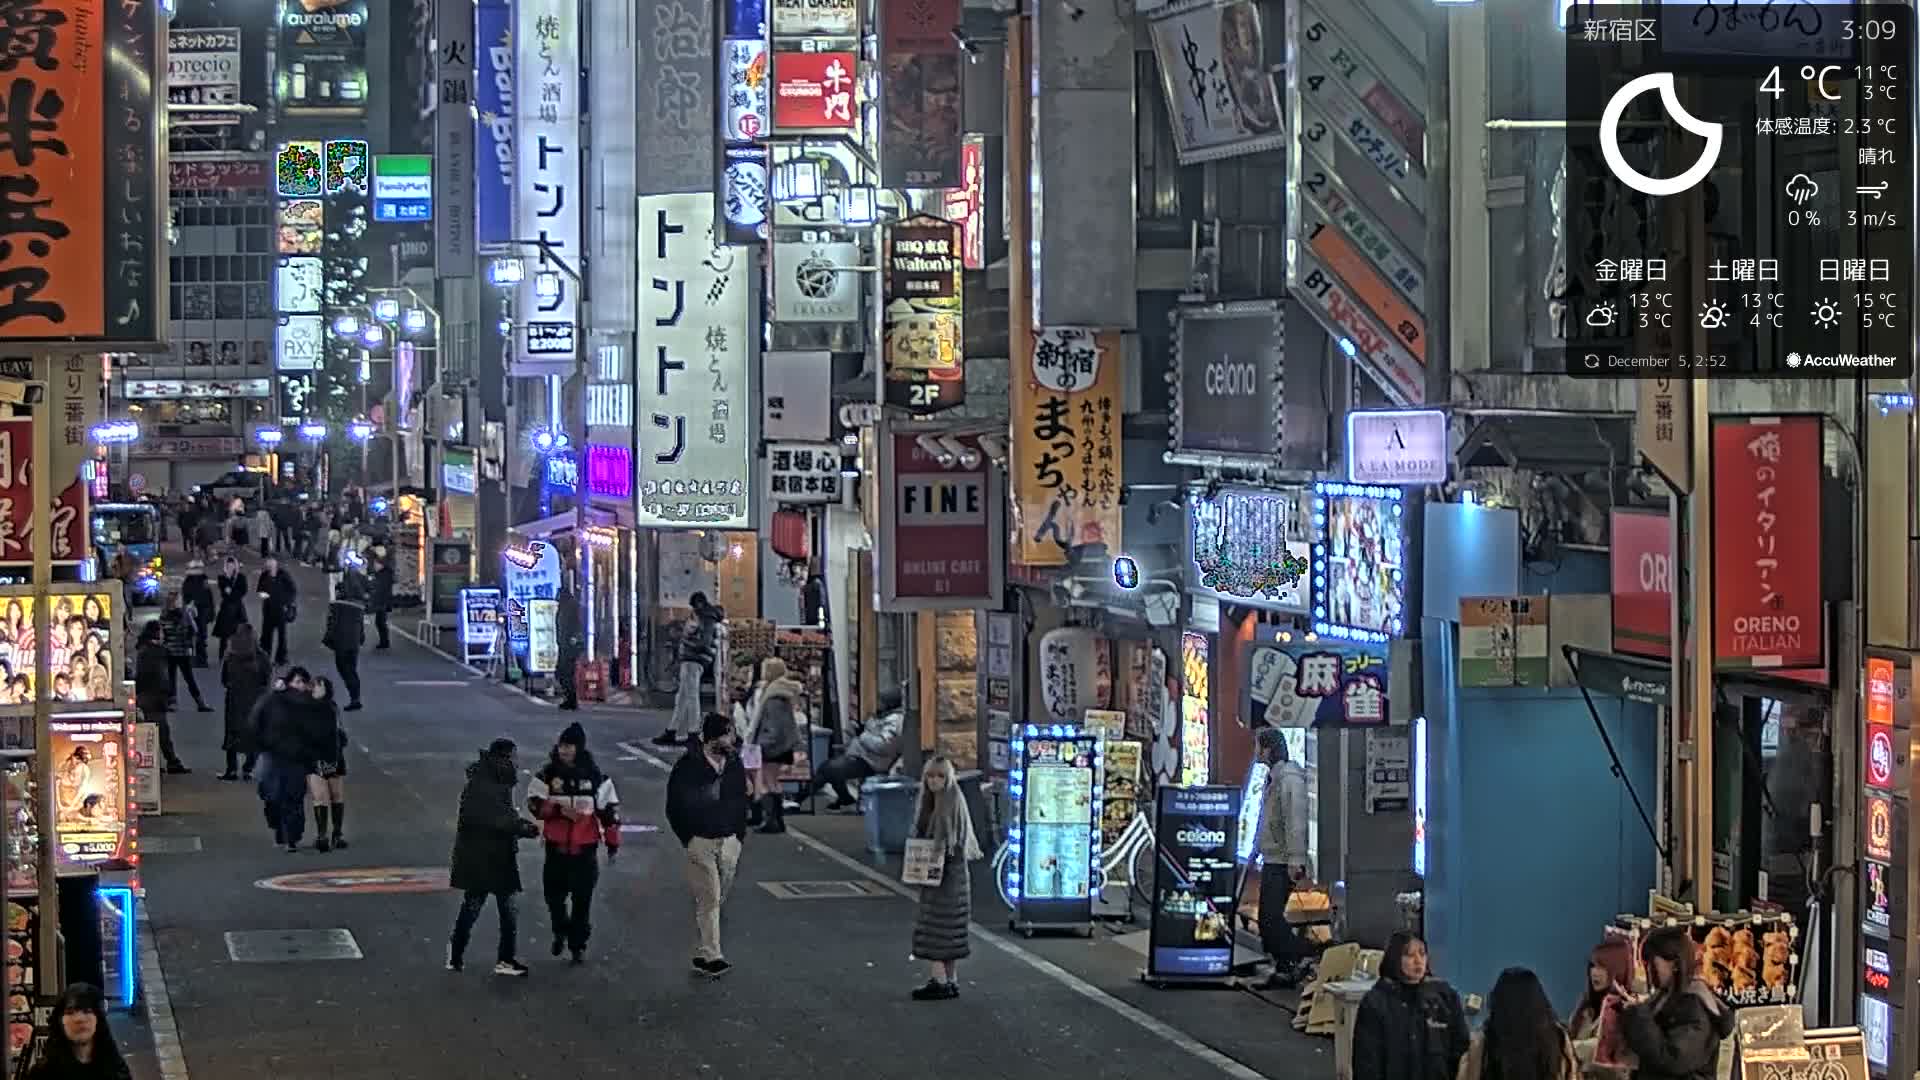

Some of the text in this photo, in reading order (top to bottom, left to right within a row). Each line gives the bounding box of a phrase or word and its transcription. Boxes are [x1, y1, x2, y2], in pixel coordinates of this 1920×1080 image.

[1306, 22, 1327, 42] 5
[823, 59, 852, 121] 牛門
[1307, 74, 1325, 91] 4
[1307, 122, 1327, 142] 3
[378, 181, 429, 192] FamilyMart
[1305, 172, 1326, 194] 2
[533, 136, 565, 313] トントン
[893, 255, 952, 271] Walton's
[652, 209, 686, 464] トントン
[1036, 339, 1095, 374] 新宿
[704, 325, 729, 443] 焼とん酒場
[1205, 354, 1256, 395] celona
[64, 351, 85, 447] 通り一番街
[909, 384, 940, 406] 2F
[772, 450, 836, 472] 酒場心
[1033, 396, 1078, 549] まっちゃん
[772, 475, 836, 494] 新宿本店
[904, 484, 980, 514] FINE
[1747, 432, 1784, 611] 俺のイタリアン
[903, 560, 981, 575] ONLINE CAFE
[1733, 615, 1801, 634] ORENO
[1732, 634, 1801, 652] ITALIAN
[1343, 653, 1384, 673] フリー
[1296, 651, 1384, 723] 麻雀
[1176, 828, 1225, 843] celona
